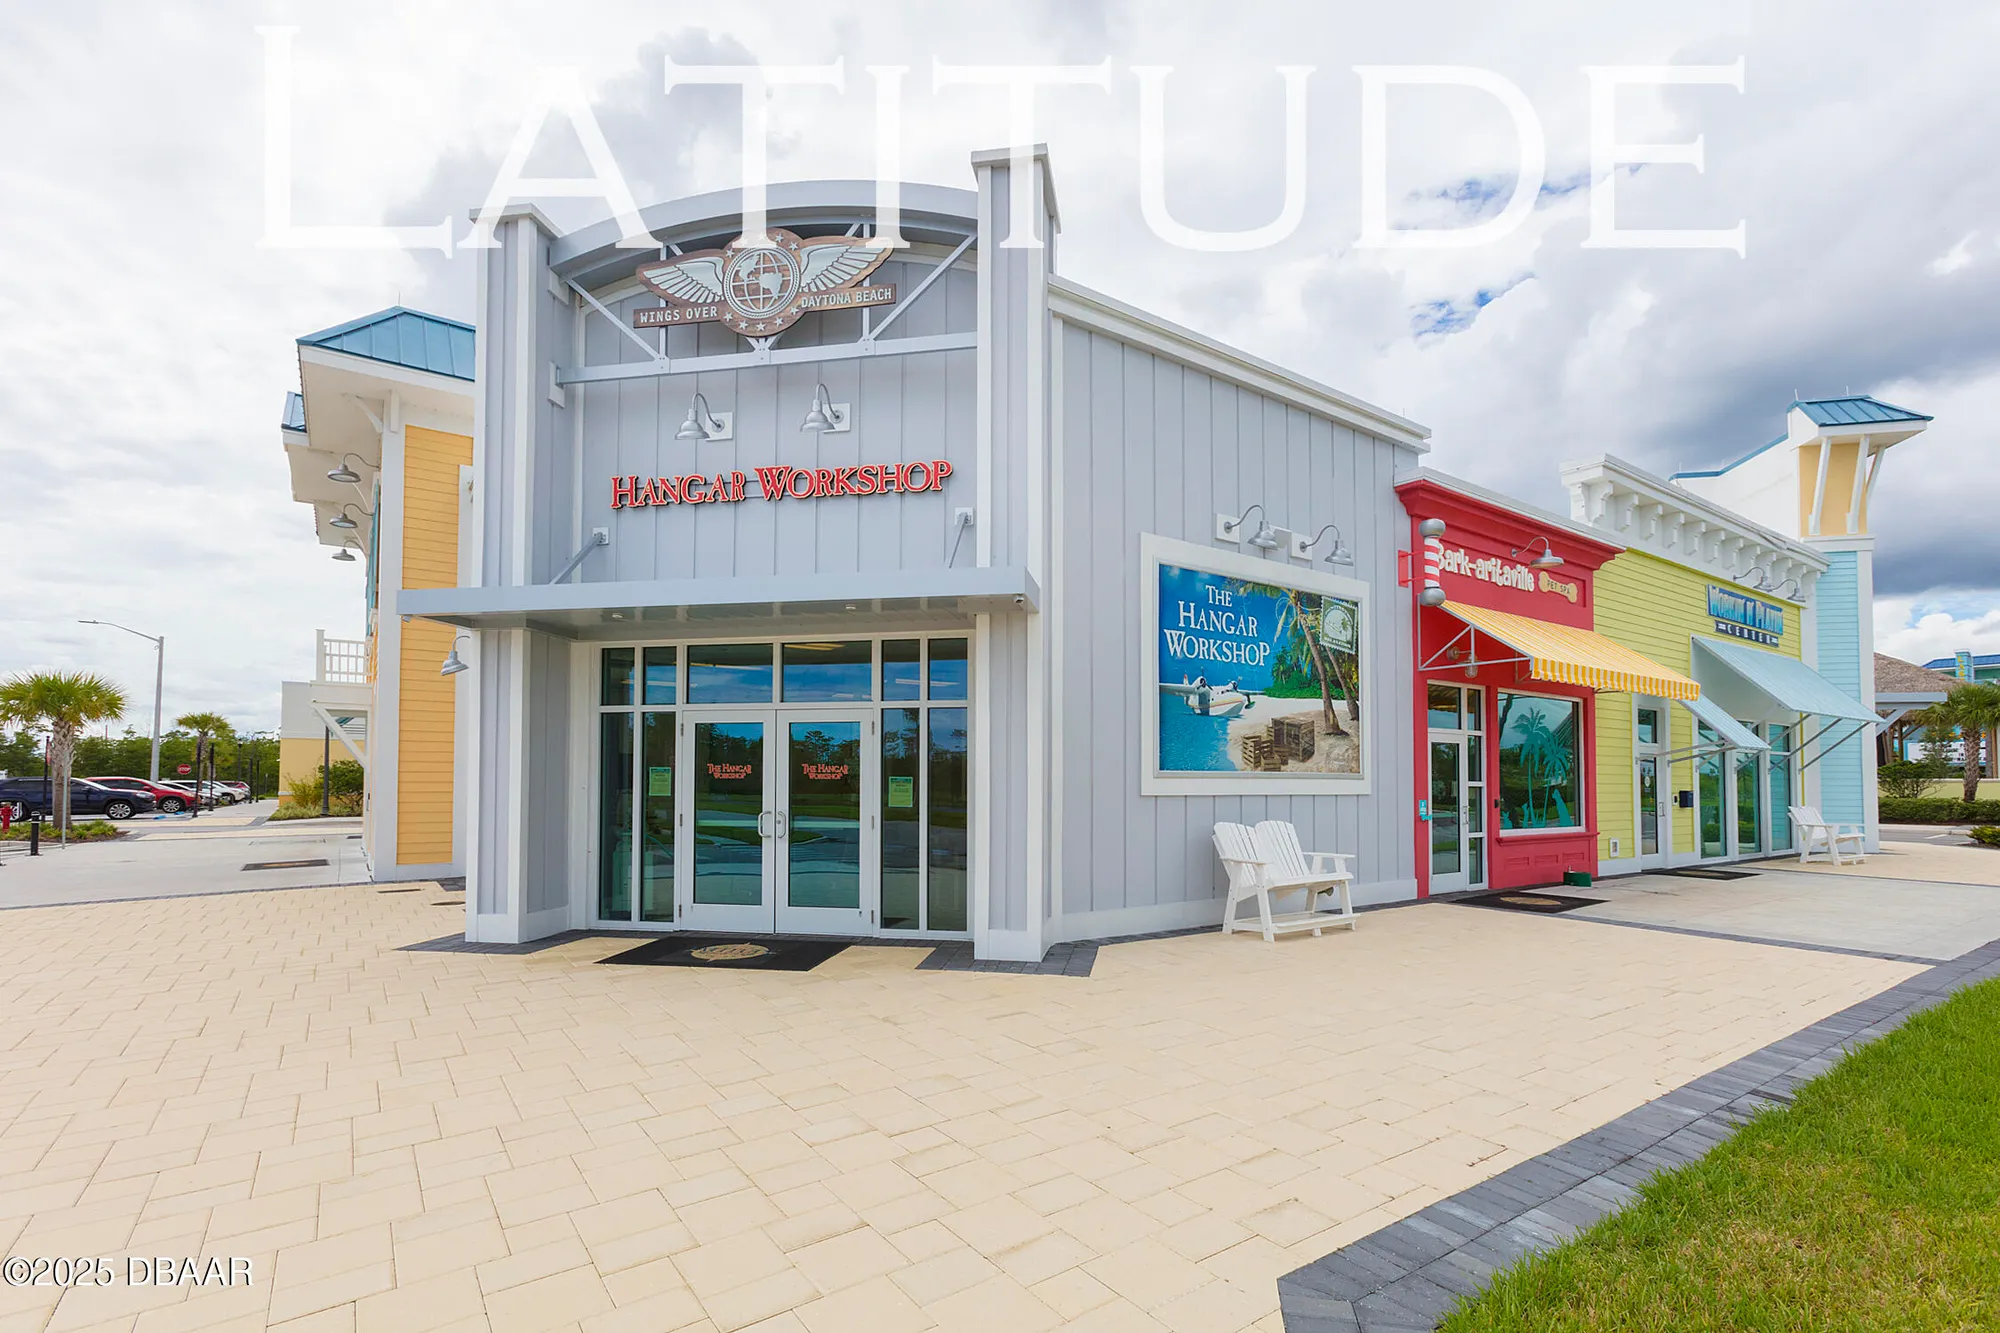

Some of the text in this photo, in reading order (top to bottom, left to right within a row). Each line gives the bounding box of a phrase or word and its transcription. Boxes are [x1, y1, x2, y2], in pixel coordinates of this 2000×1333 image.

[801, 289, 892, 308] DAYTONA BEACH
[640, 306, 718, 323] WINGS OVER
[611, 459, 953, 508] HANGAR WORKSHOP
[1205, 584, 1232, 607] THE
[1547, 580, 1570, 594] PET SPA
[1178, 600, 1258, 637] HANGAR
[1727, 624, 1771, 645] CENTER
[1164, 628, 1270, 667] WORKSHOP
[707, 763, 752, 774] THE HANGAR
[801, 763, 849, 775] THE HANGAR
